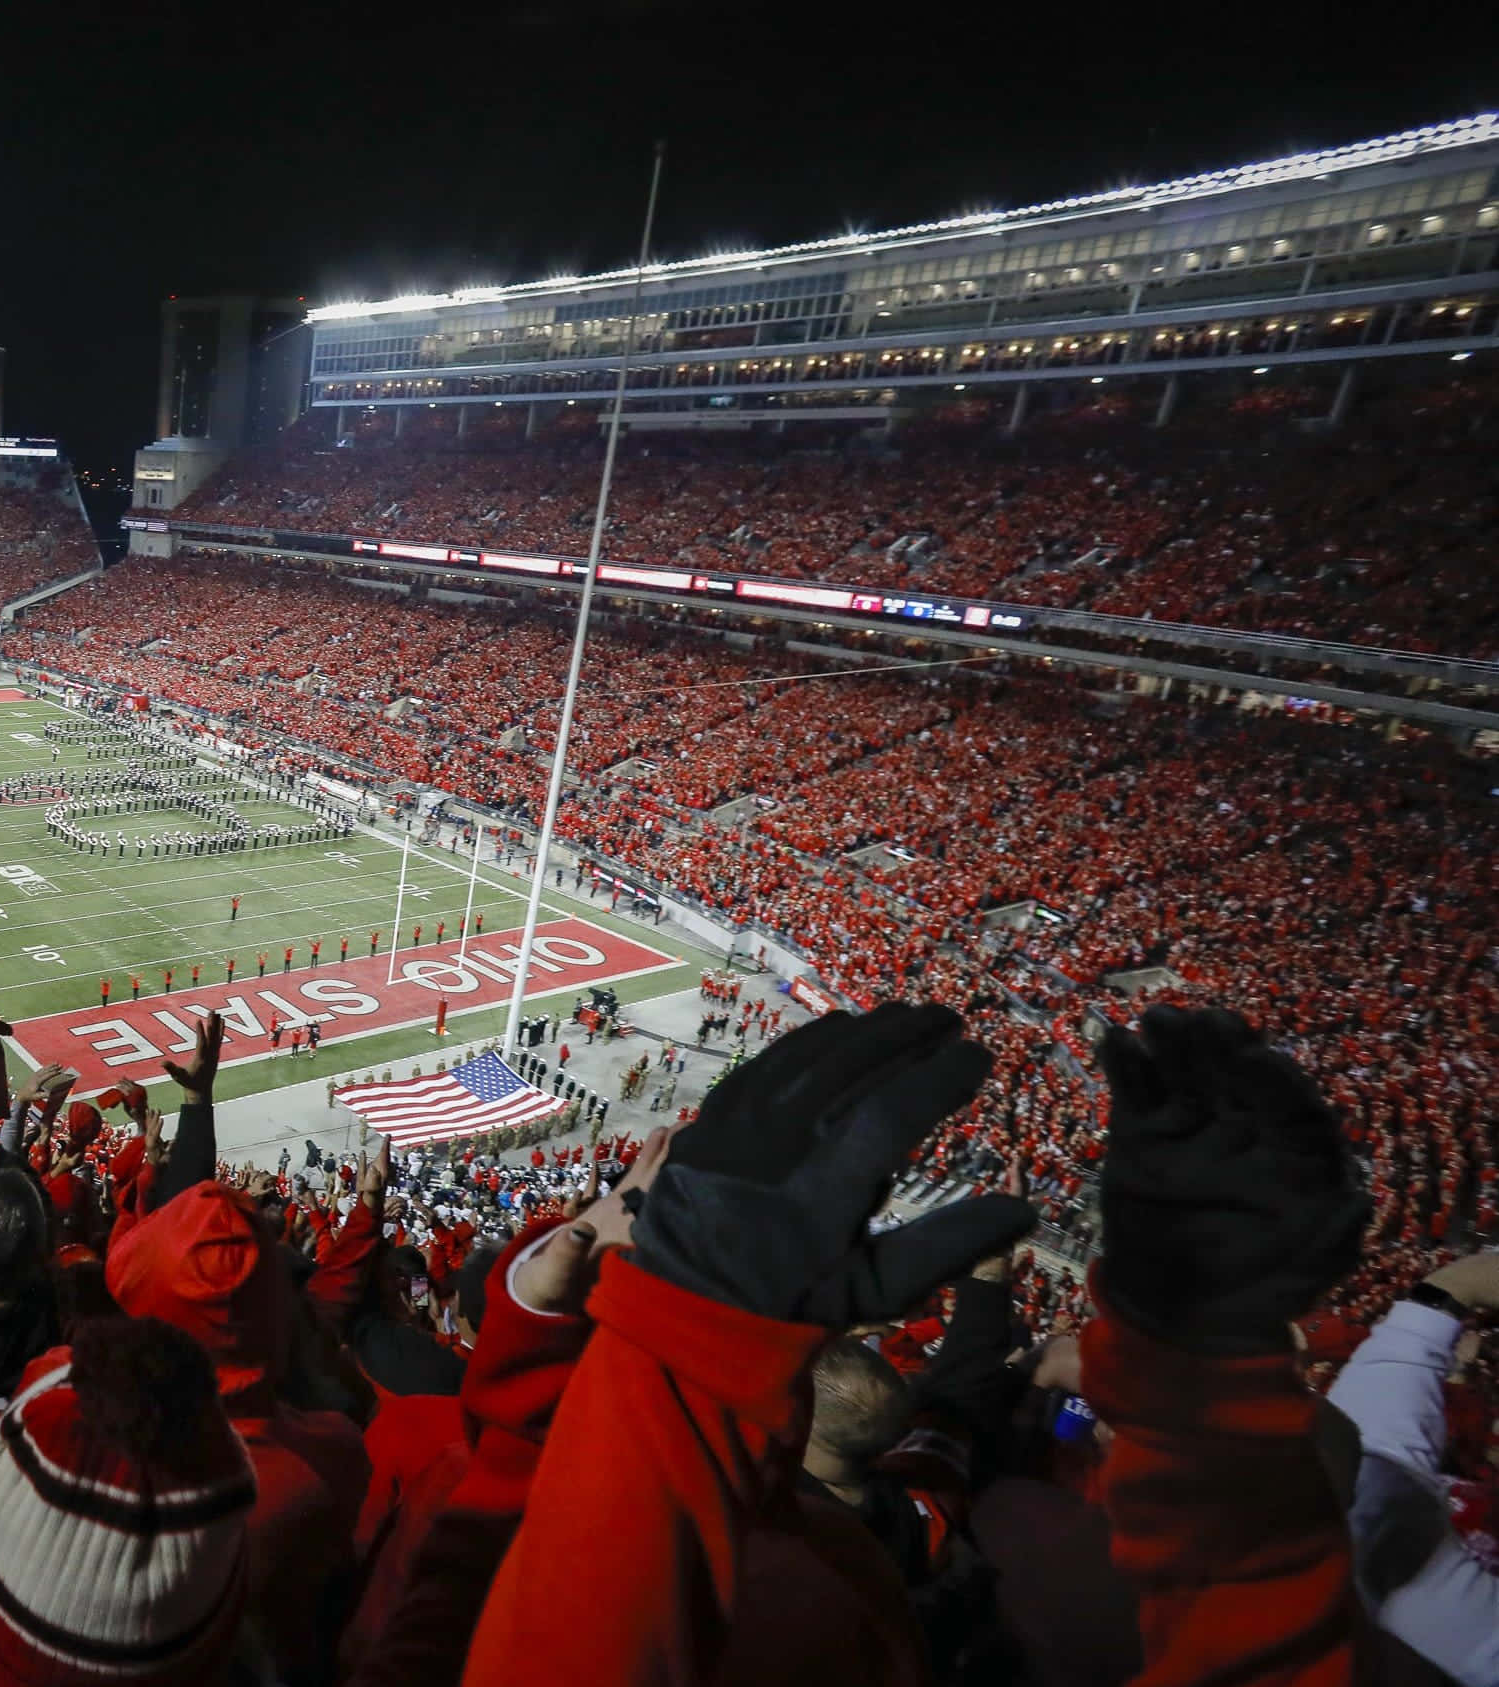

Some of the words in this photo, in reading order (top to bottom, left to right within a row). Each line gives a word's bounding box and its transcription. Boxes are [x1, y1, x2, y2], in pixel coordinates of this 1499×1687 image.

[22, 944, 61, 962] 10
[402, 936, 606, 993] OHIO
[69, 979, 380, 1067] STATE
